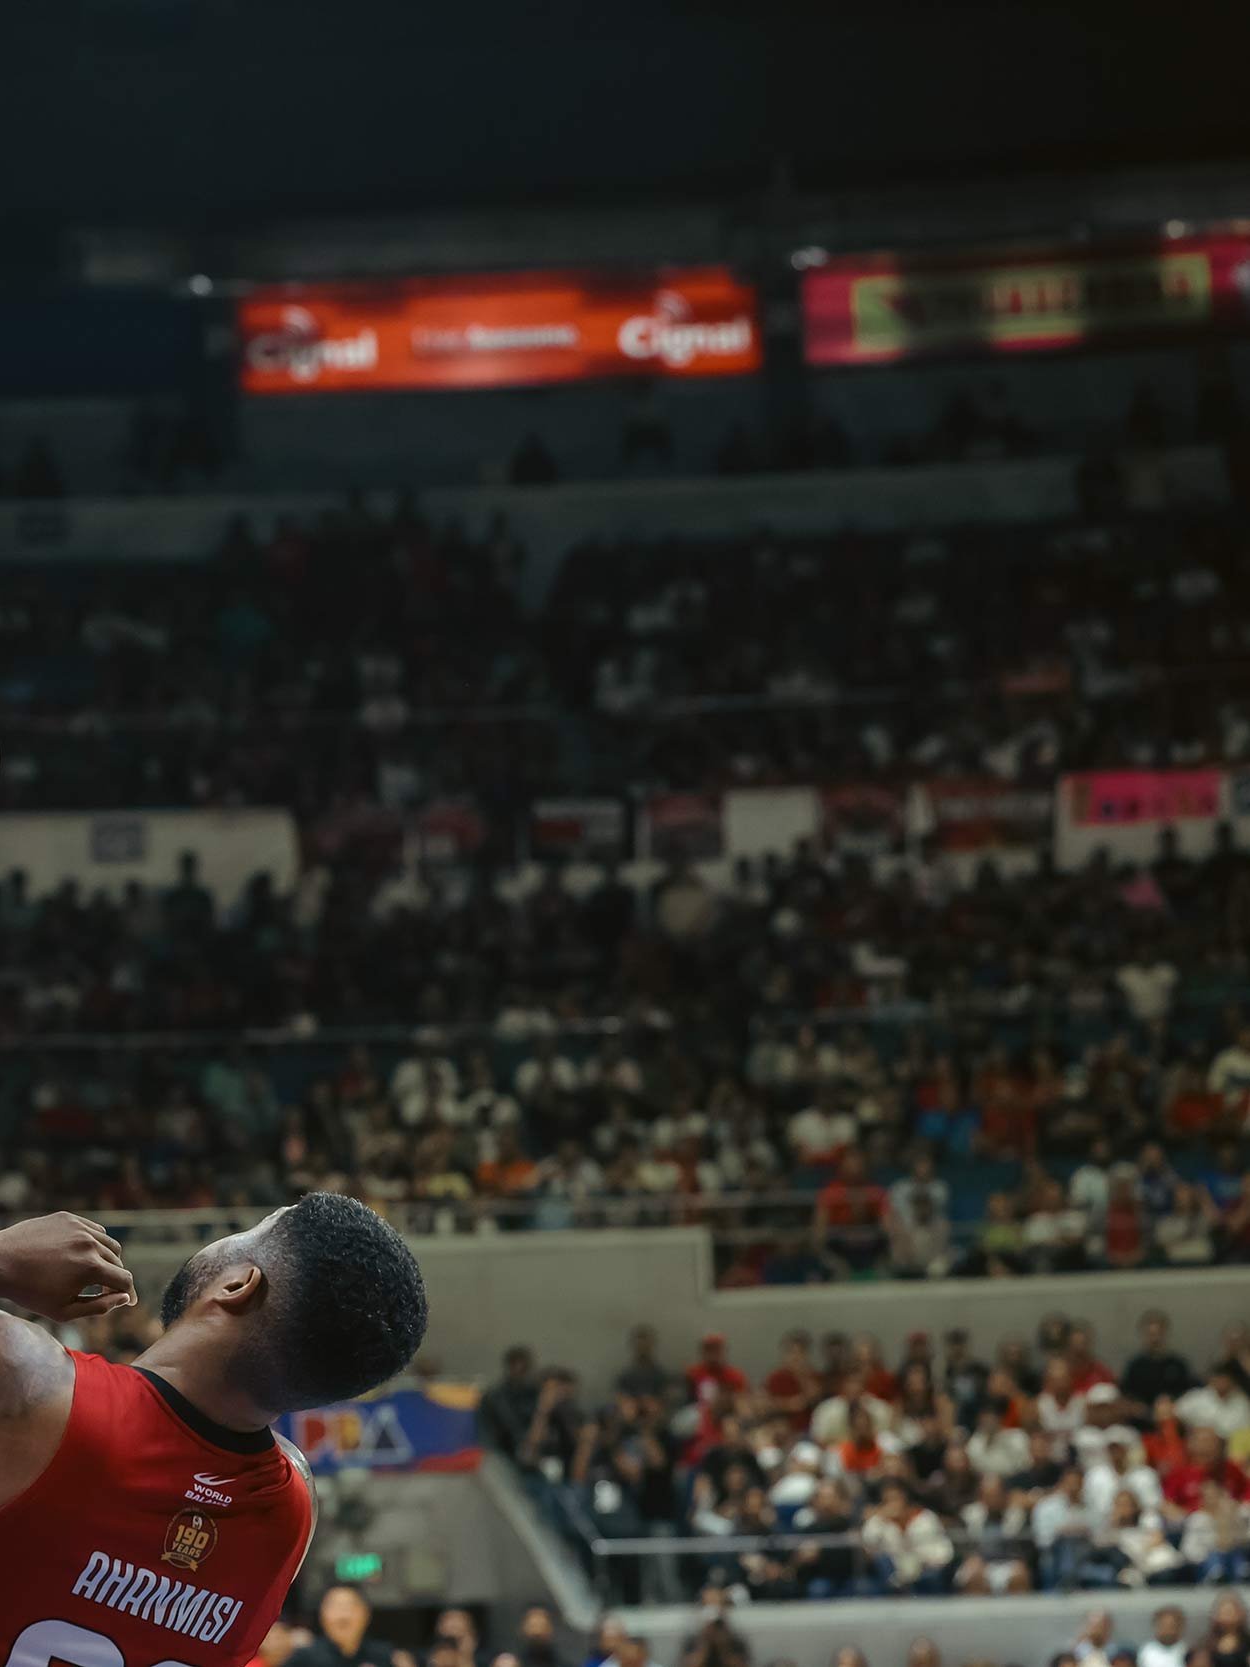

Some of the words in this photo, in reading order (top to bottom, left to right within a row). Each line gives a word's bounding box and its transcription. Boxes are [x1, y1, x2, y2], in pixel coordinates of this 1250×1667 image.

[193, 1483, 233, 1505] WORLD
[175, 1524, 210, 1549] 190
[171, 1541, 203, 1559] YEARS
[71, 1550, 244, 1645] AHANMISI
